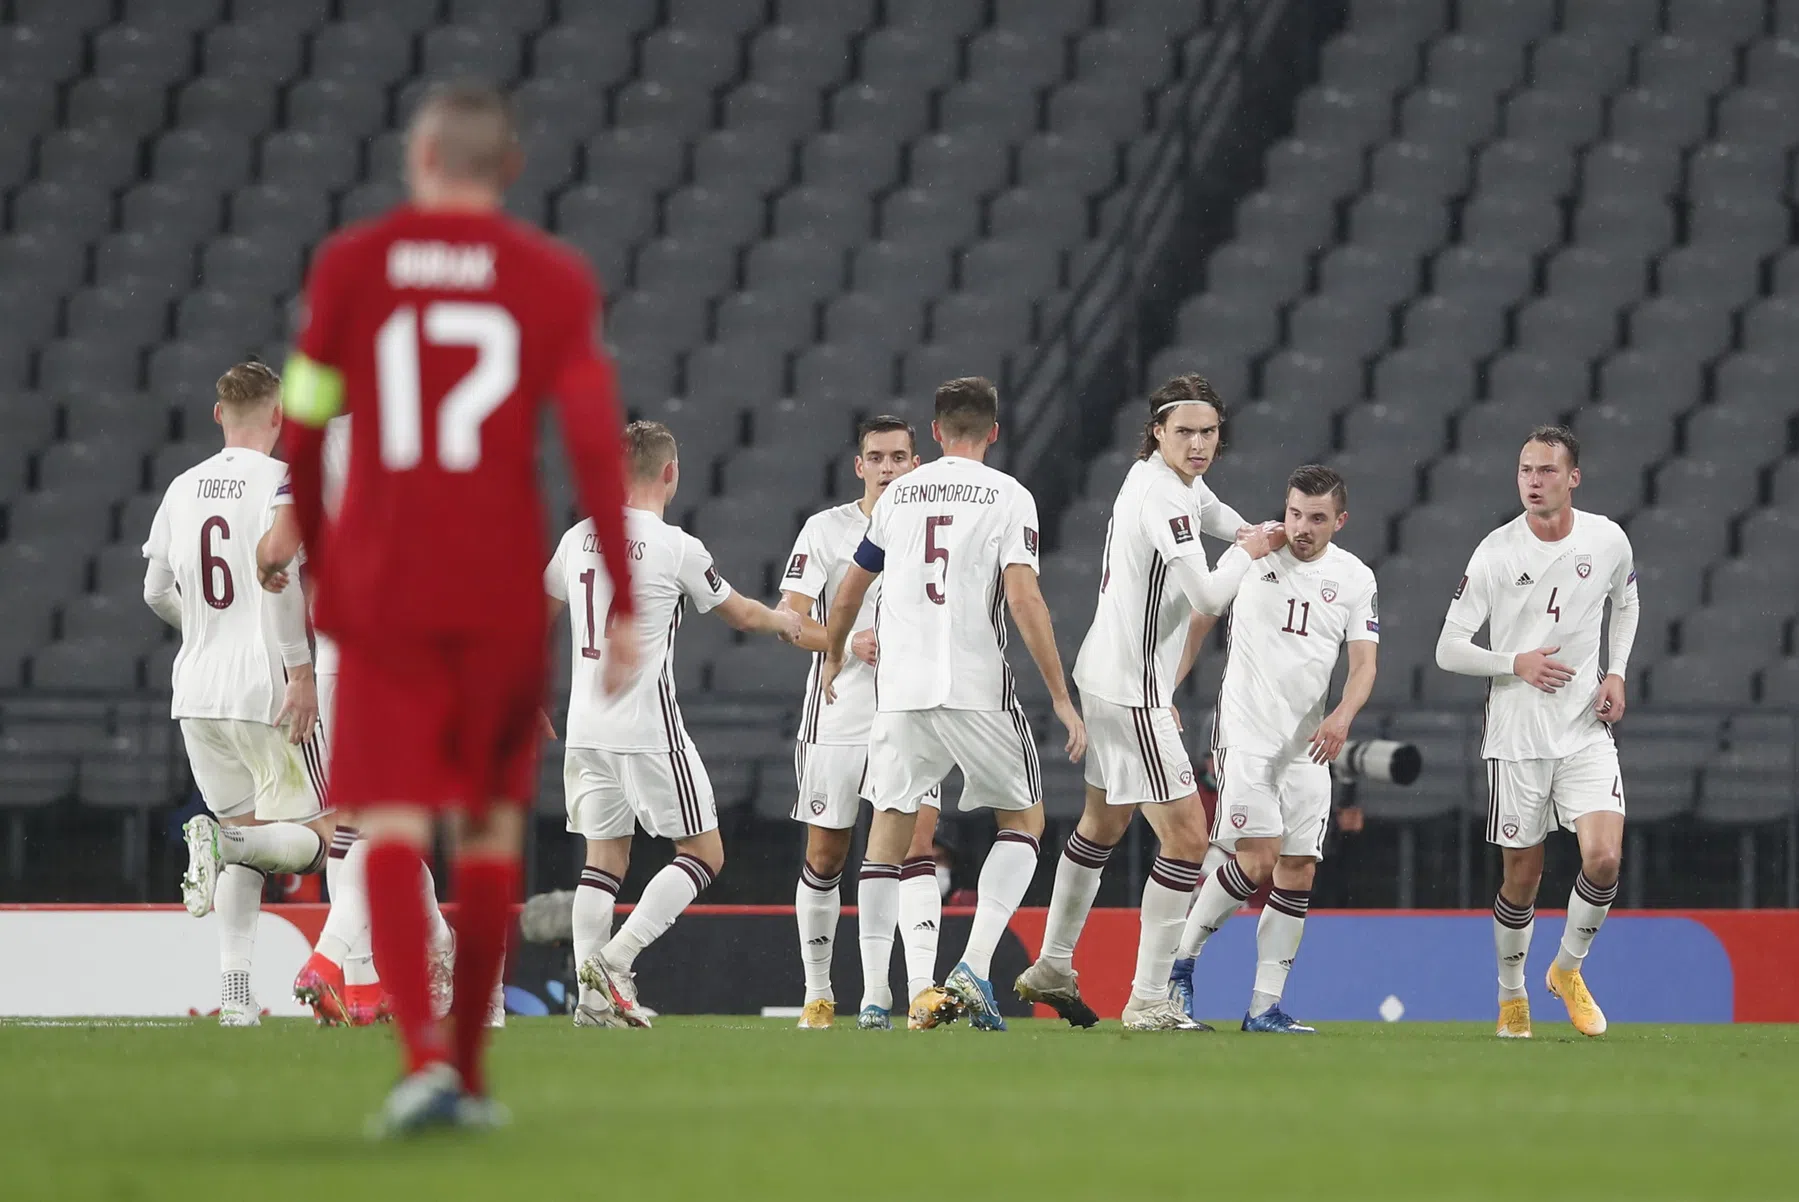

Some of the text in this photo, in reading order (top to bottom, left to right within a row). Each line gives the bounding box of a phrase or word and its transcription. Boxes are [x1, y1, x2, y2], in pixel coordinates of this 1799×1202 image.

[375, 302, 521, 472] 17
[197, 479, 246, 499] TOBERS
[894, 483, 999, 505] ČERNOMORDIJS
[201, 515, 234, 610] 6
[925, 515, 954, 605] 5
[1281, 598, 1310, 636] 11
[1546, 587, 1560, 623] 4
[1611, 775, 1622, 807] 4
